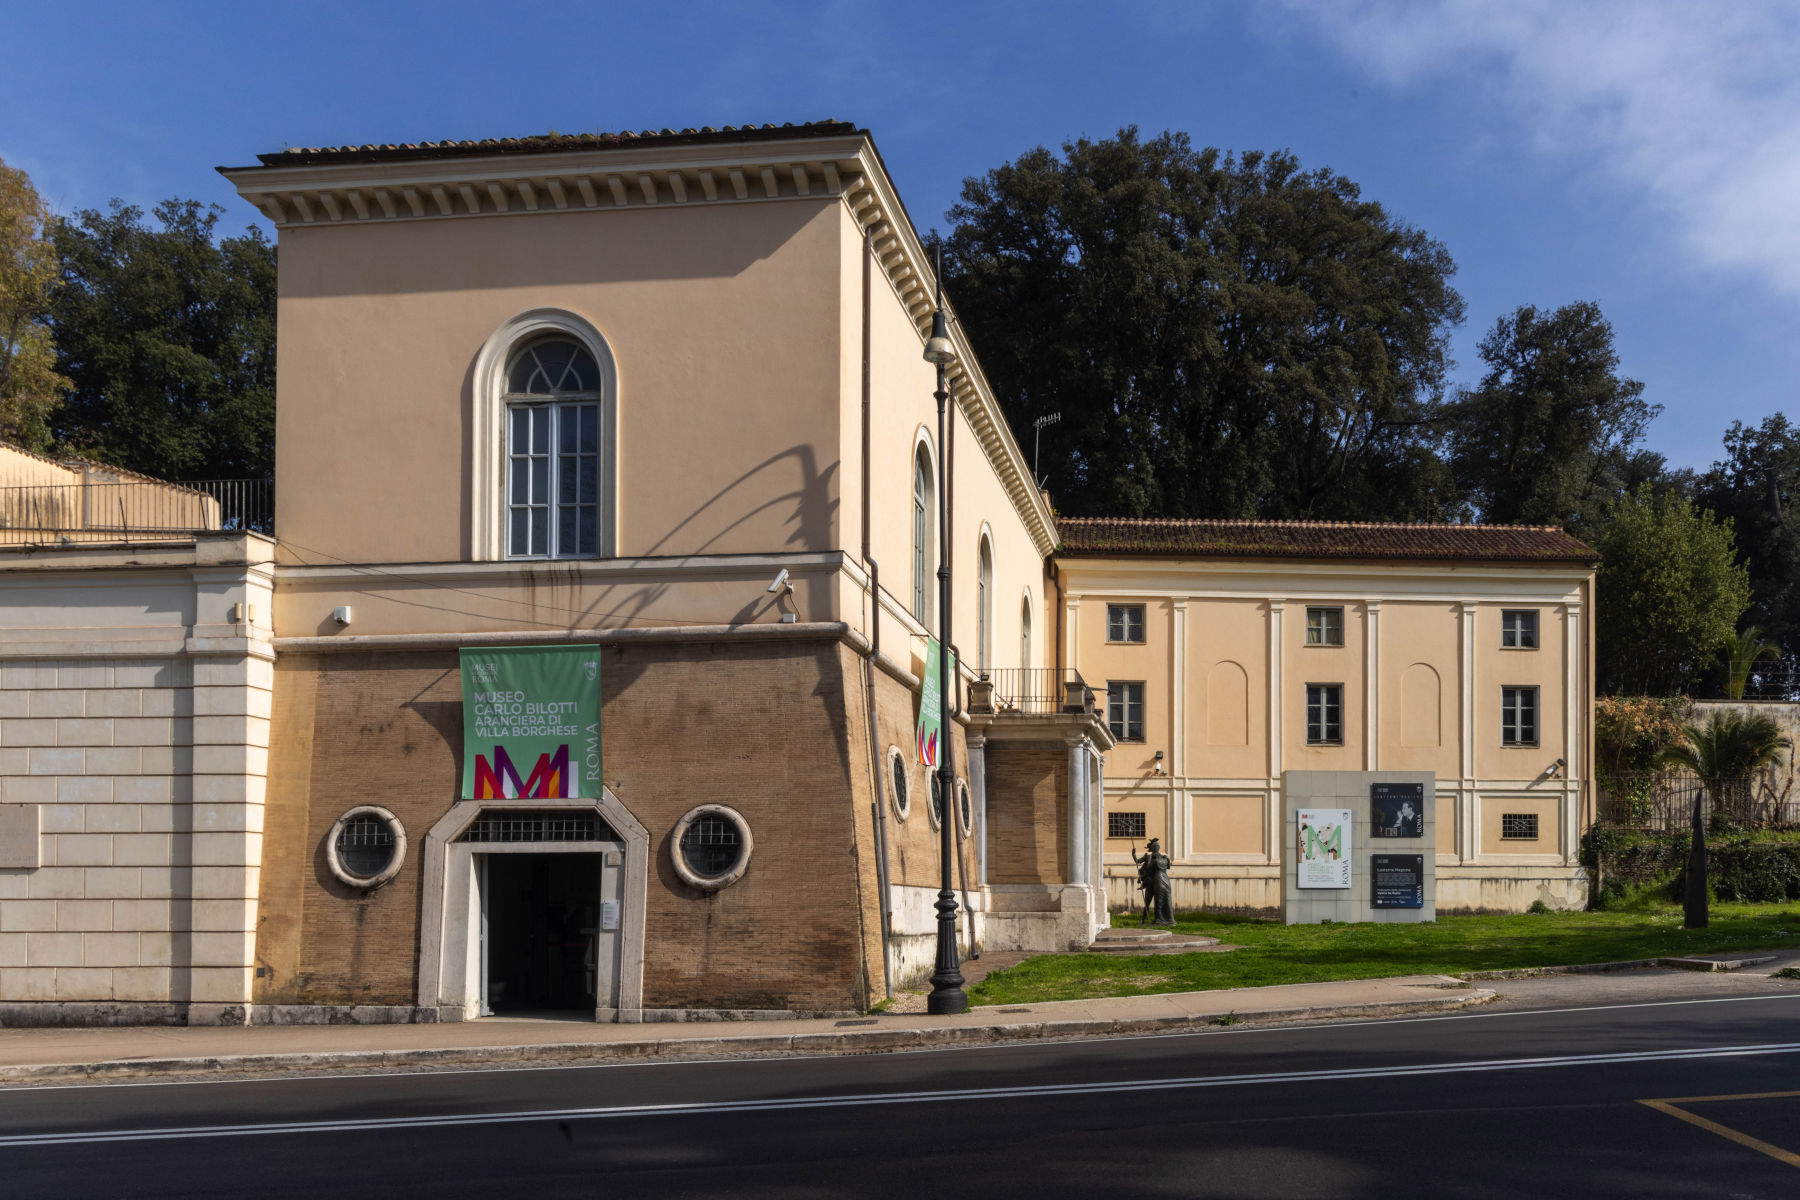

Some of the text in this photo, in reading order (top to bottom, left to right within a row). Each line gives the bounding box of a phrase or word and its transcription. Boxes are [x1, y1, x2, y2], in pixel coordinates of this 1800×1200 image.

[474, 691, 525, 703] MUSEO
[474, 702, 578, 716] CARLO BILOTTI
[475, 714, 562, 727] ARANCIERA DI
[475, 725, 578, 737] VILLA BORGHESE
[586, 723, 599, 781] ROMA
